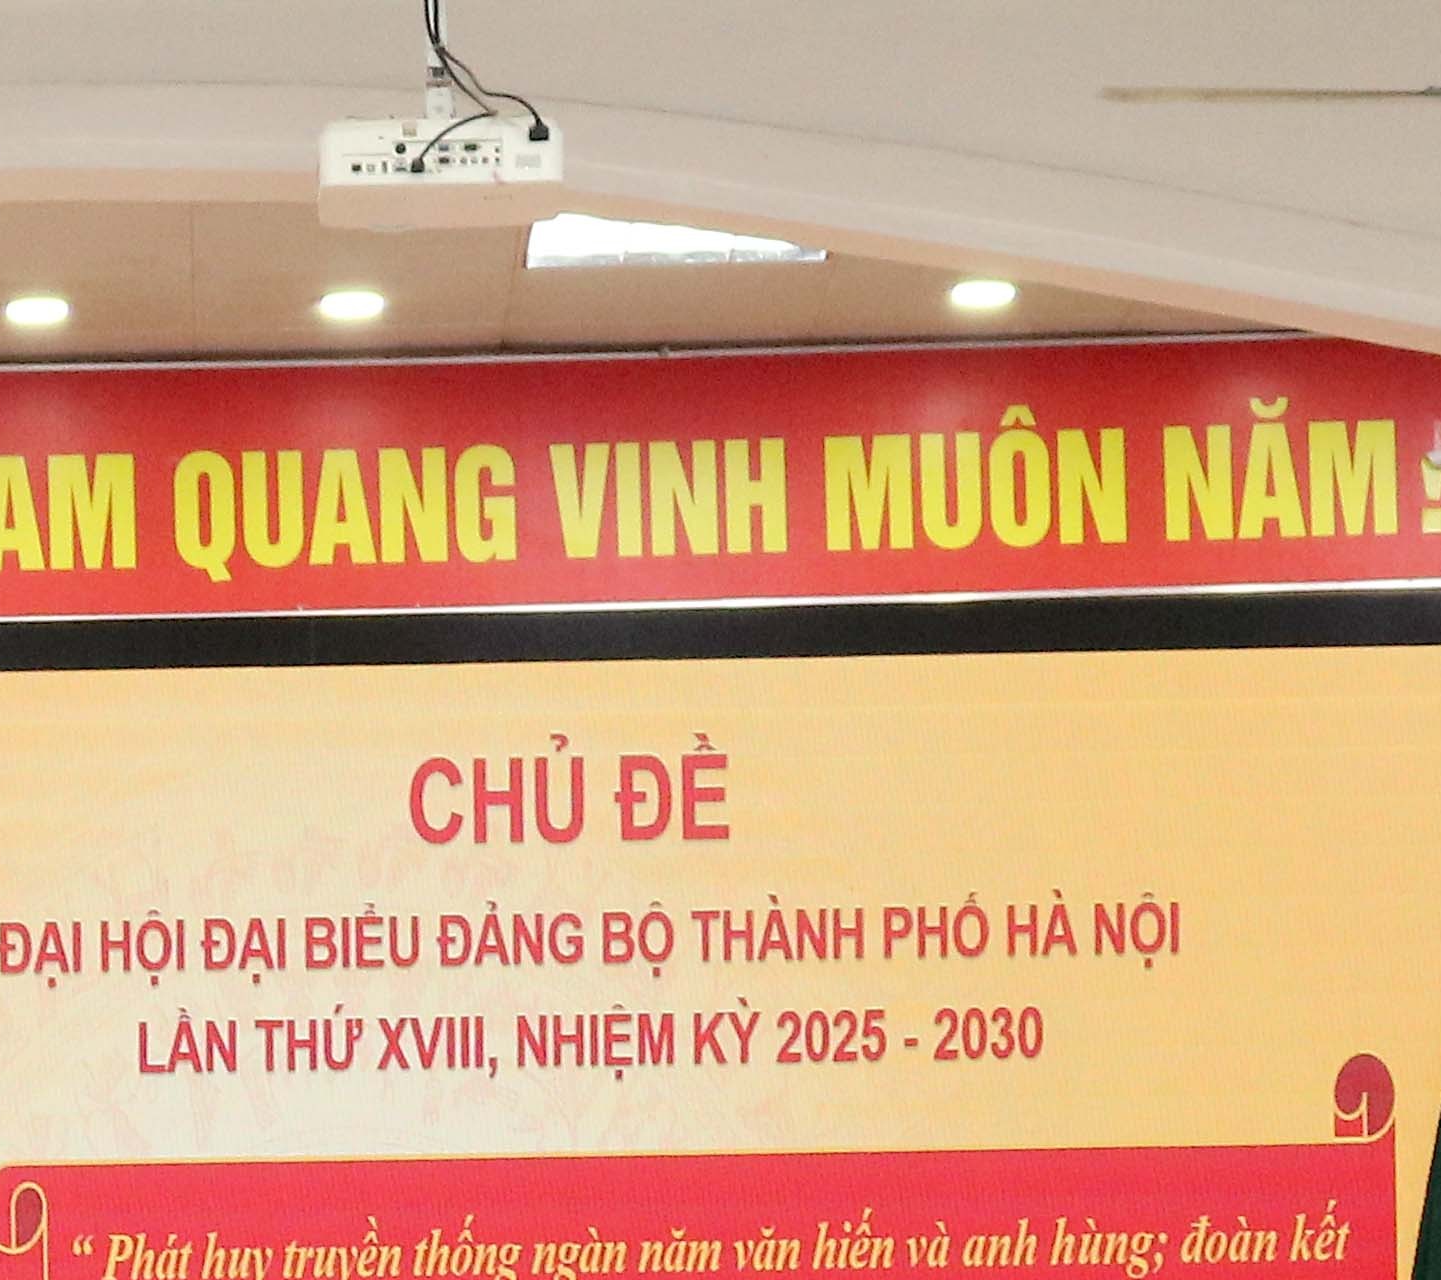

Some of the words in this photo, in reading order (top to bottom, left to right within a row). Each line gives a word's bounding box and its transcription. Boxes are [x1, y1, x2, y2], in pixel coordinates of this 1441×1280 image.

[174, 445, 517, 582] QUANG
[551, 439, 788, 558] VINH
[824, 405, 1127, 551] MUÔN
[410, 734, 584, 844] CHỦ
[614, 733, 730, 841] ĐỀ
[101, 911, 185, 985] HỘI
[201, 918, 286, 983] ĐẠI
[305, 903, 419, 969] BIỂU
[437, 900, 584, 967] ĐẢNG
[603, 903, 674, 976] BỘ
[691, 896, 864, 961] THÀNH
[883, 889, 990, 959] PHỐ
[1007, 888, 1077, 957] HÀ
[1094, 886, 1180, 968] NỘI
[139, 1006, 237, 1073] LẦN
[256, 1004, 363, 1071] THỨ
[379, 1017, 497, 1074] XVIII,
[517, 1005, 674, 1075] NHIỆM
[694, 997, 760, 1064] KỲ
[777, 1009, 886, 1064] 2025
[934, 1007, 1043, 1061] 2030
[102, 1233, 192, 1280] Phát
[639, 1228, 721, 1272] năm
[734, 1228, 800, 1270] văn
[813, 1208, 894, 1269] hiến
[907, 1222, 950, 1267] và
[963, 1218, 1036, 1267] anh
[1051, 1218, 1168, 1278] hùng;
[1181, 1216, 1277, 1263] đoàn
[1290, 1200, 1350, 1261] kết
